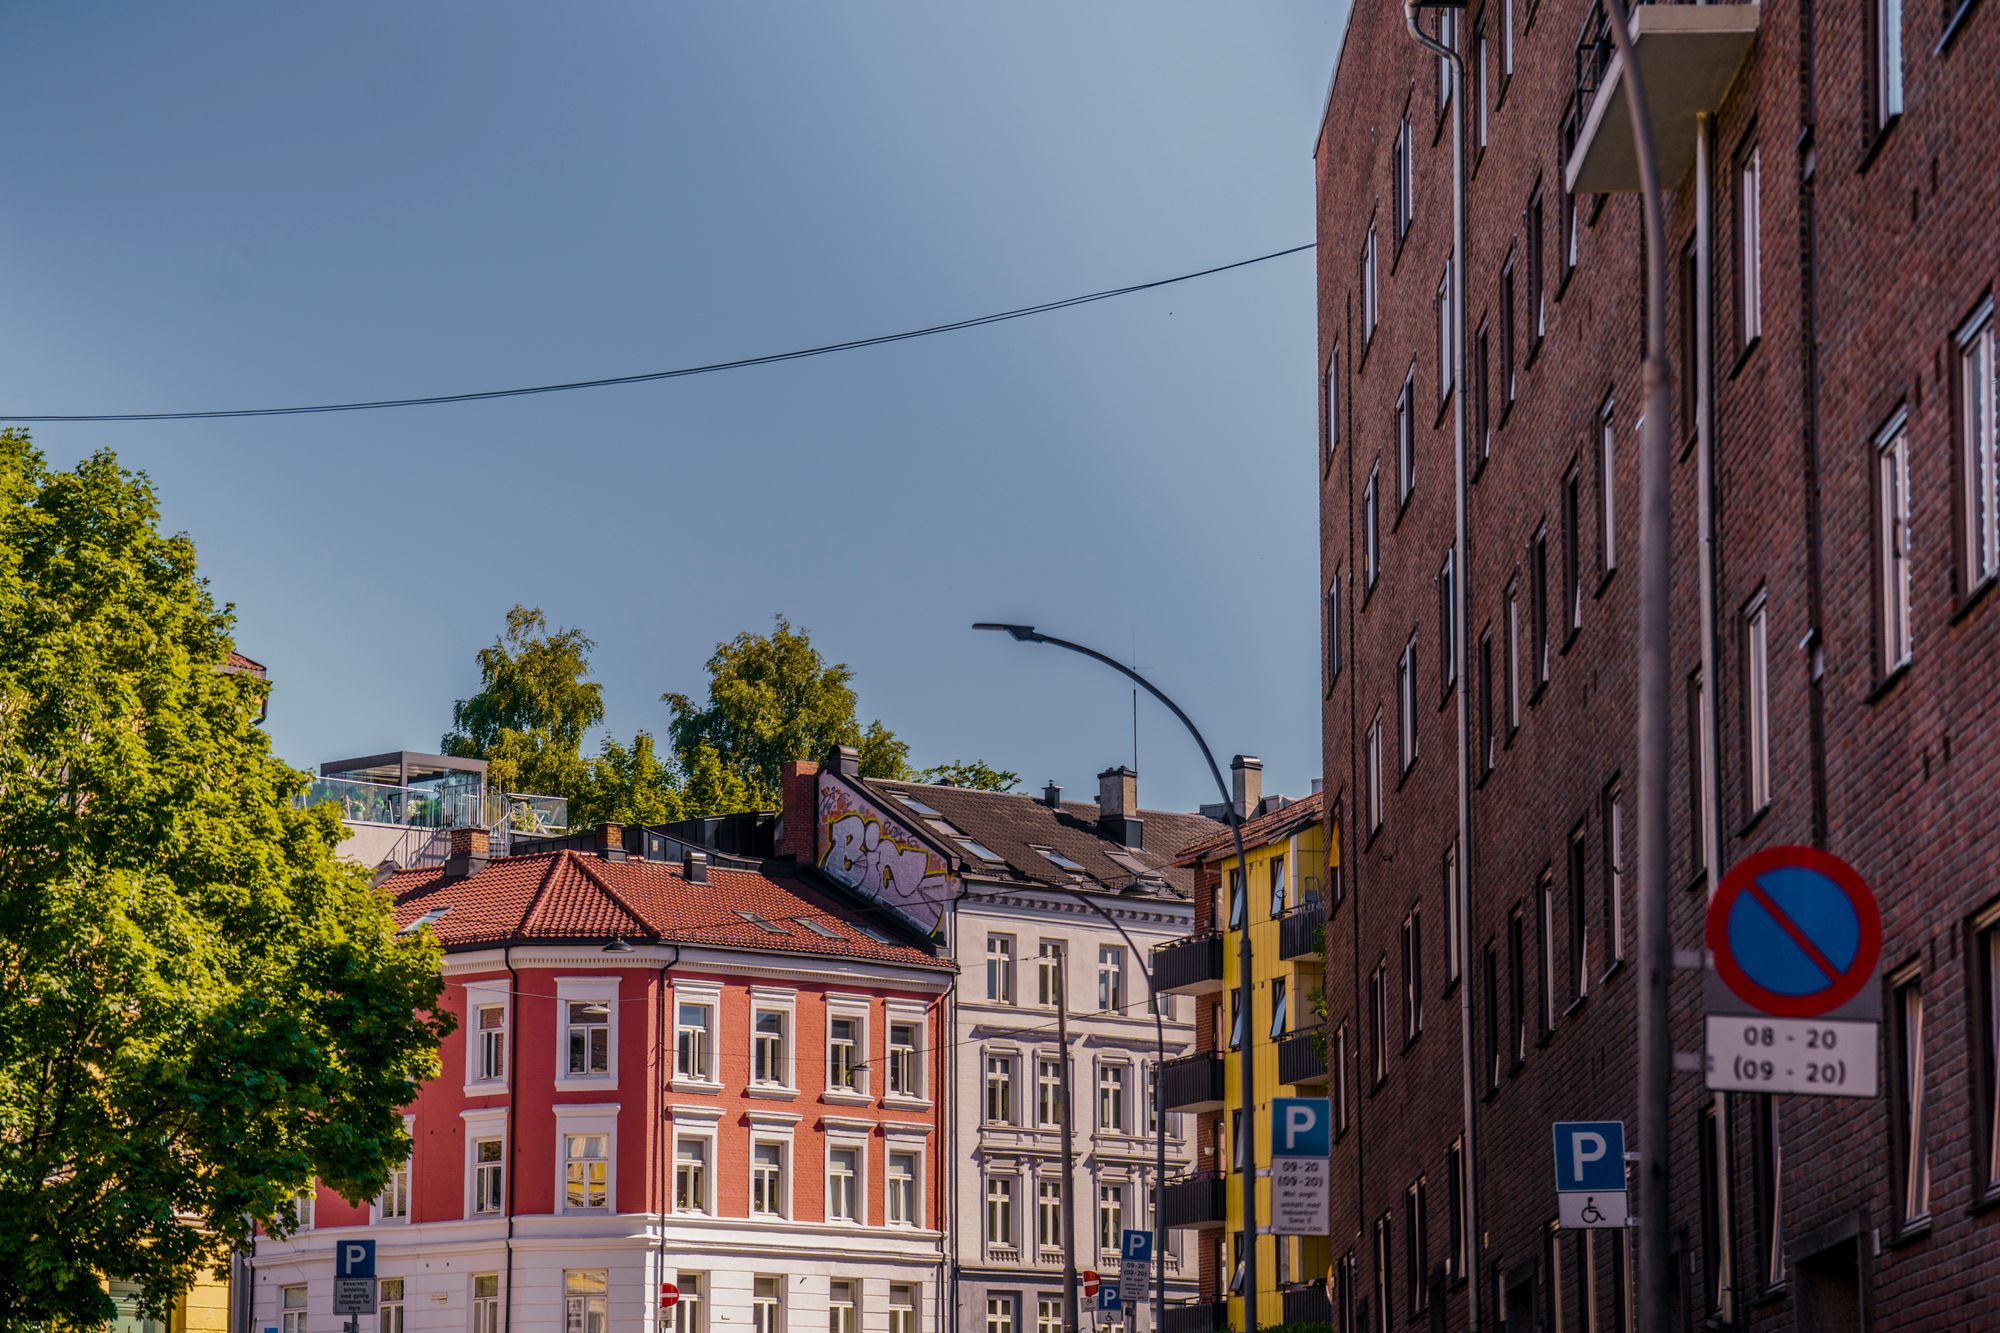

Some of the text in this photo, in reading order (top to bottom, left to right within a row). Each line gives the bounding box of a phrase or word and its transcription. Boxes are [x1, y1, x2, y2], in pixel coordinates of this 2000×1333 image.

[1744, 1026, 1775, 1047] 08
[1806, 1029, 1837, 1050] 20
[1733, 1055, 1774, 1082] (09
[1806, 1059, 1846, 1086] 20)
[1285, 1105, 1317, 1150] P
[1572, 1131, 1607, 1182] P
[345, 1244, 367, 1275] P
[1129, 1234, 1146, 1257] P
[1104, 1288, 1116, 1307] P
